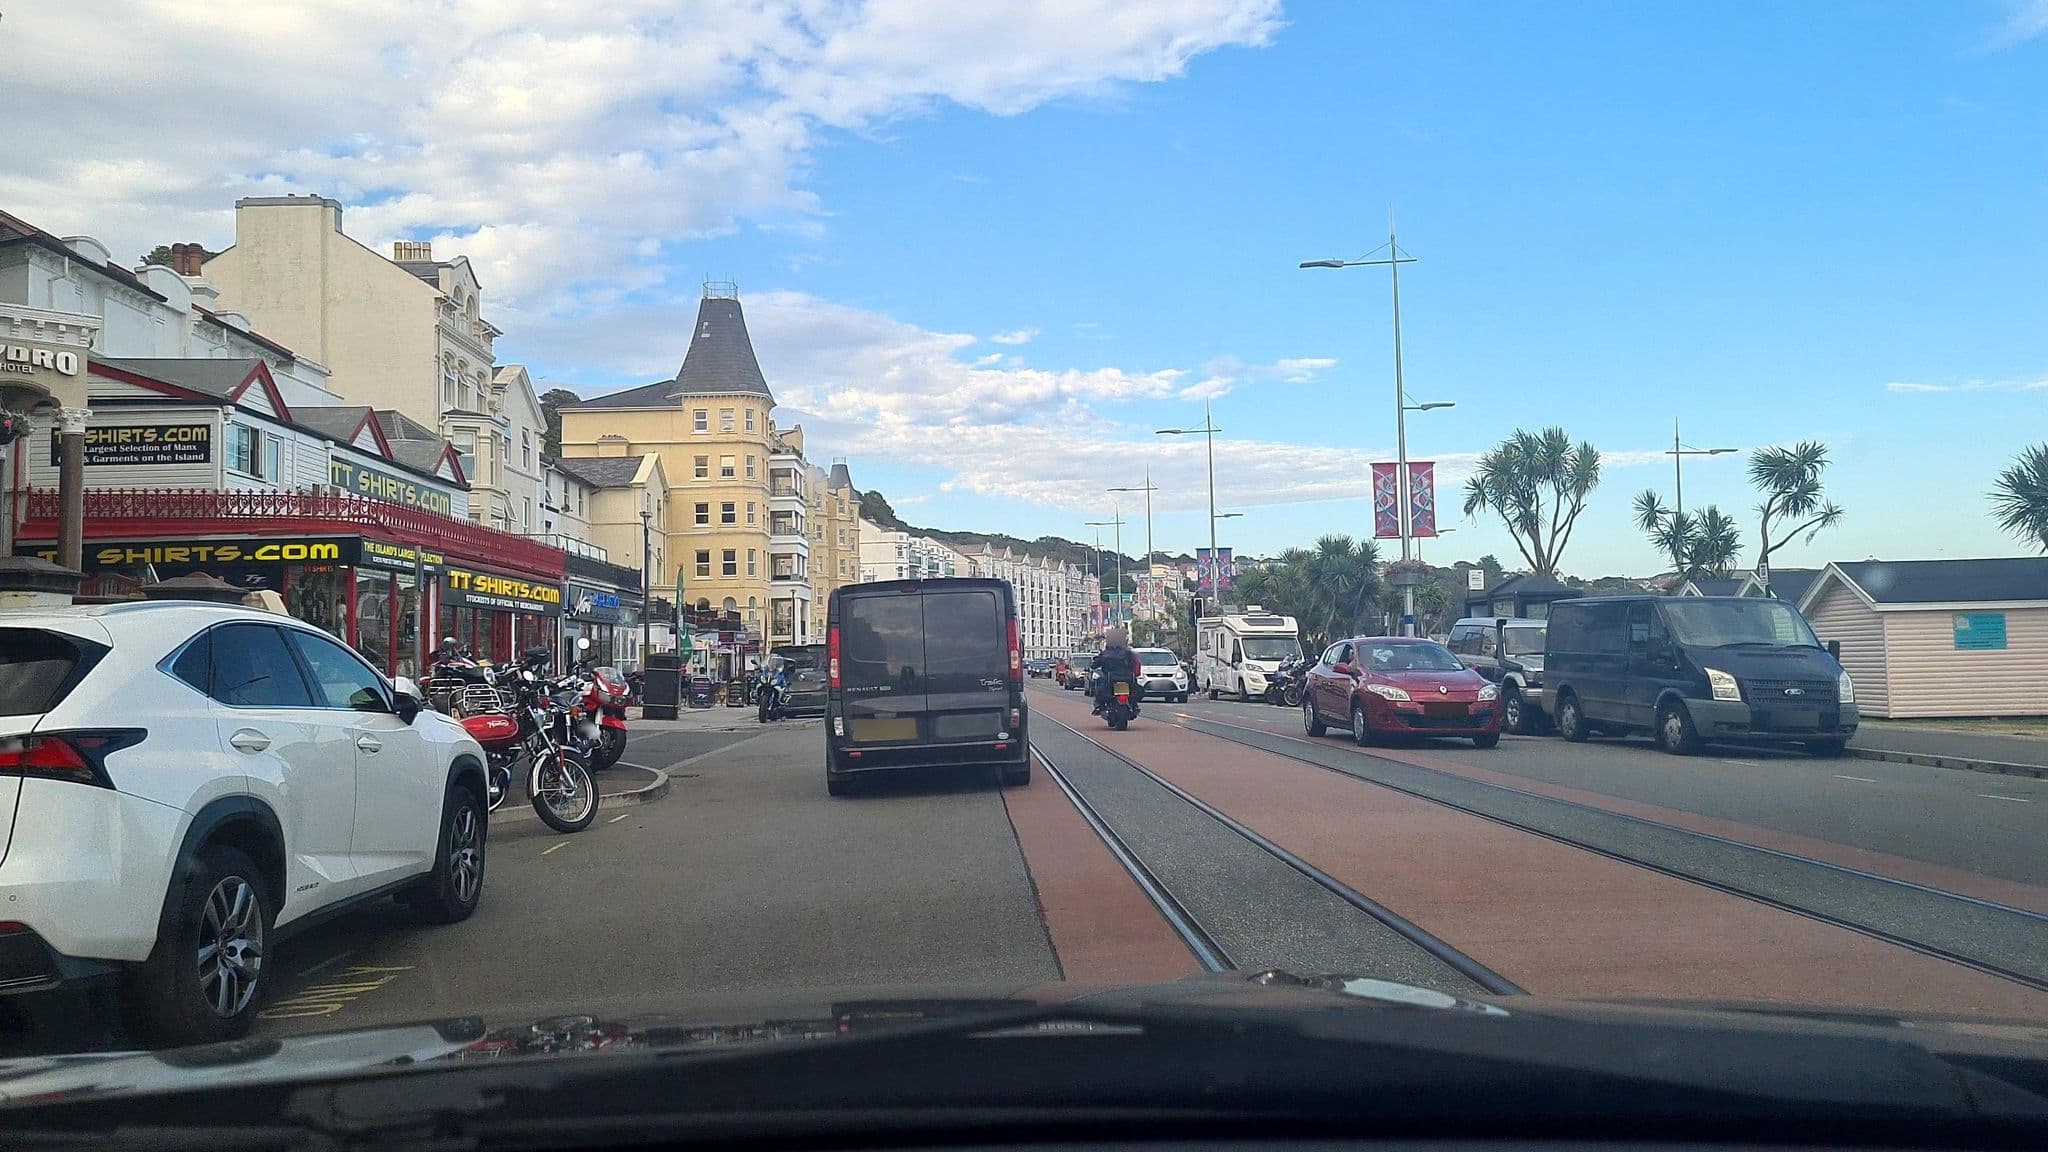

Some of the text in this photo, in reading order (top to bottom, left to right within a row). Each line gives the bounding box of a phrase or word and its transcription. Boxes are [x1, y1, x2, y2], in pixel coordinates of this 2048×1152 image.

[0, 362, 36, 374] HOTEL
[84, 427, 208, 444] SHIRTS.COM
[84, 443, 197, 454] Largest Selection of Manx
[92, 454, 139, 463] Garments
[156, 453, 172, 462] the
[174, 452, 205, 461] Island
[331, 460, 450, 515] TT SHIRTS.COM
[96, 543, 339, 565] SHIRTS.COM
[363, 541, 375, 553] THE
[447, 570, 471, 590] TT
[473, 575, 560, 603] SHIRTS.COM
